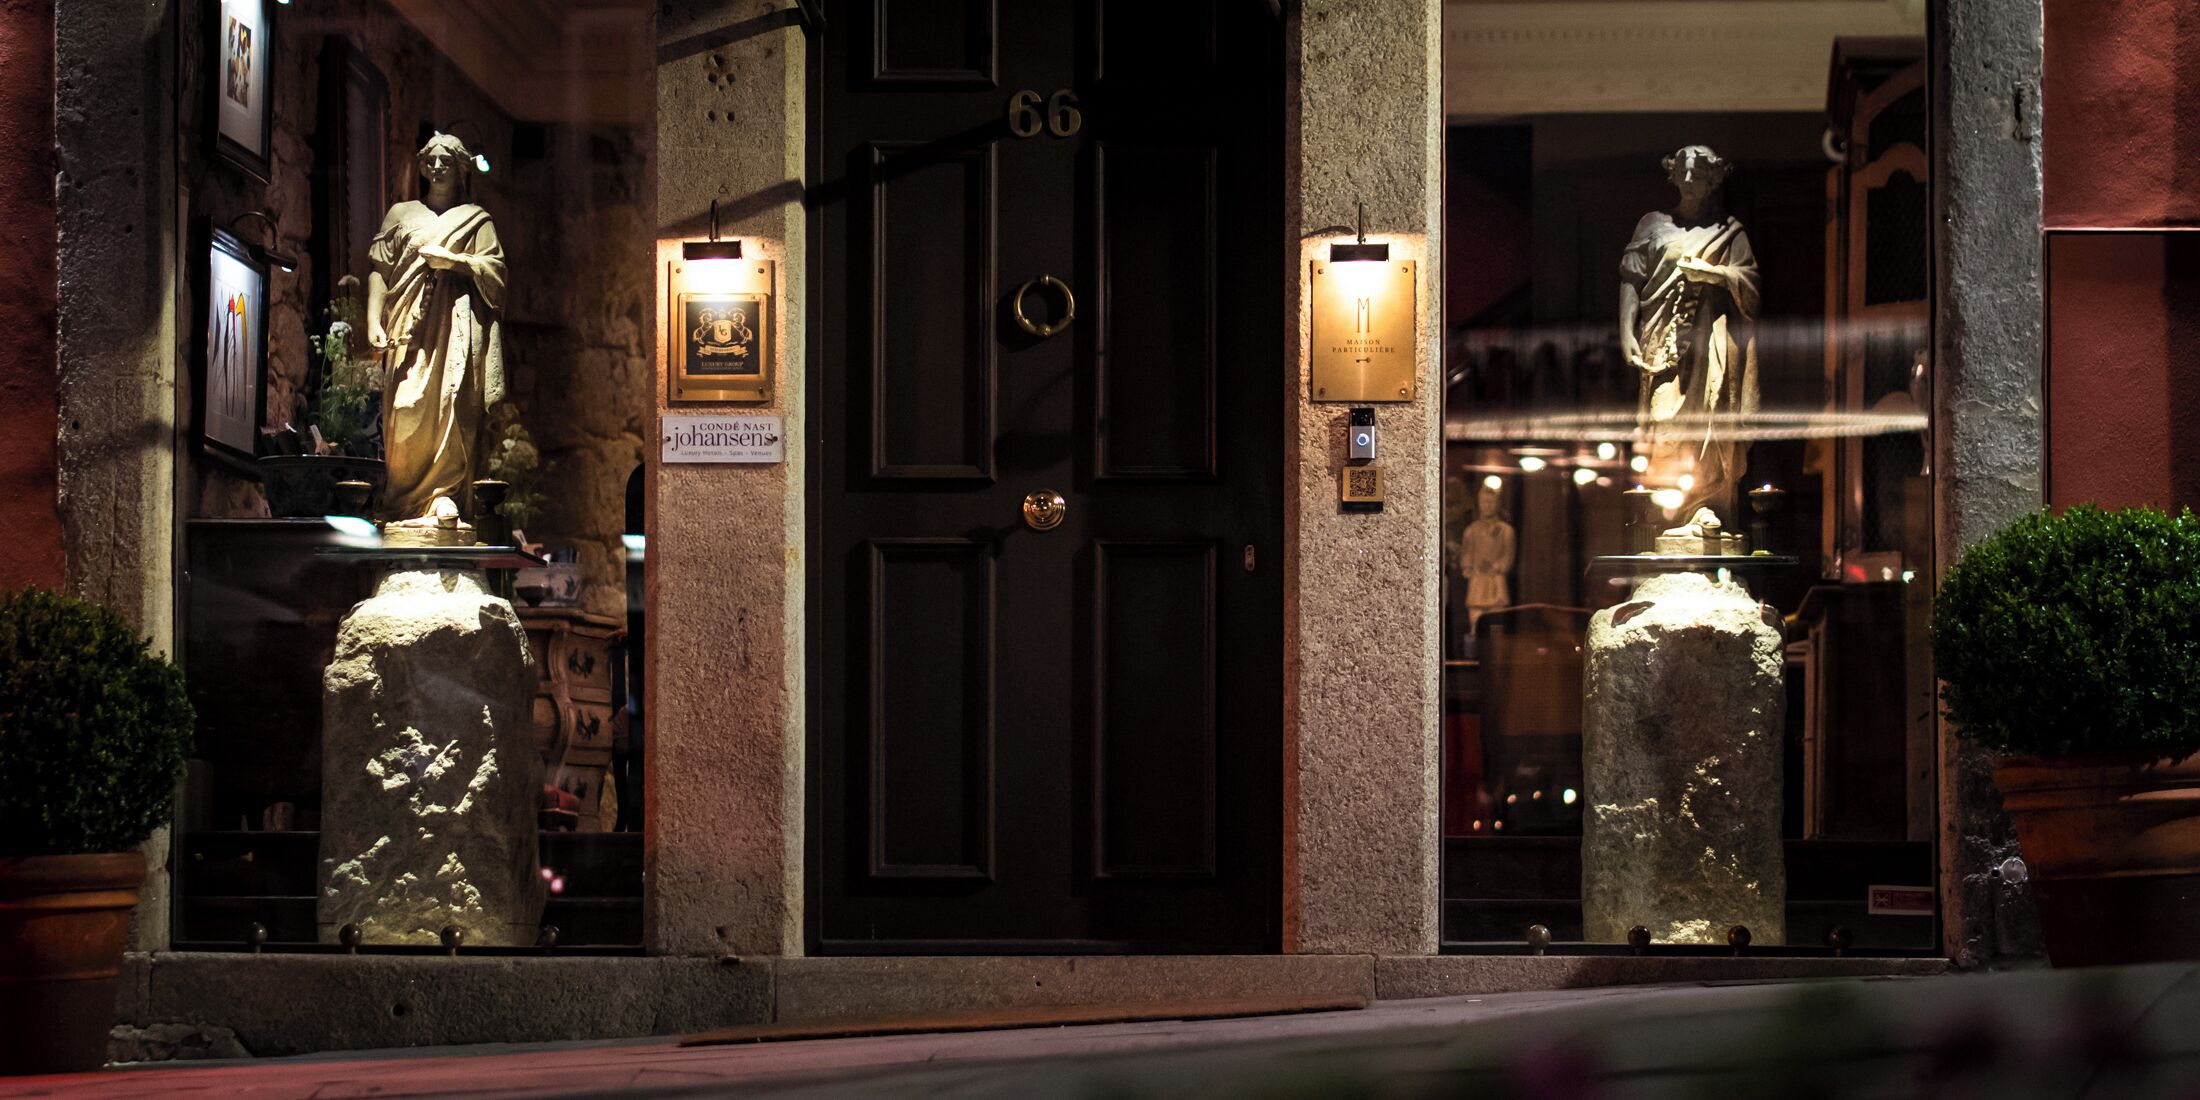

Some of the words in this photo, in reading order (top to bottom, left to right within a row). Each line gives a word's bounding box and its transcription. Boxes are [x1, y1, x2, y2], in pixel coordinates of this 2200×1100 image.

[1009, 89, 1081, 137] 66
[1356, 297, 1370, 333] M
[671, 425, 774, 452] johansens
[700, 422, 740, 431] CONDÉ
[744, 423, 773, 431] NAST
